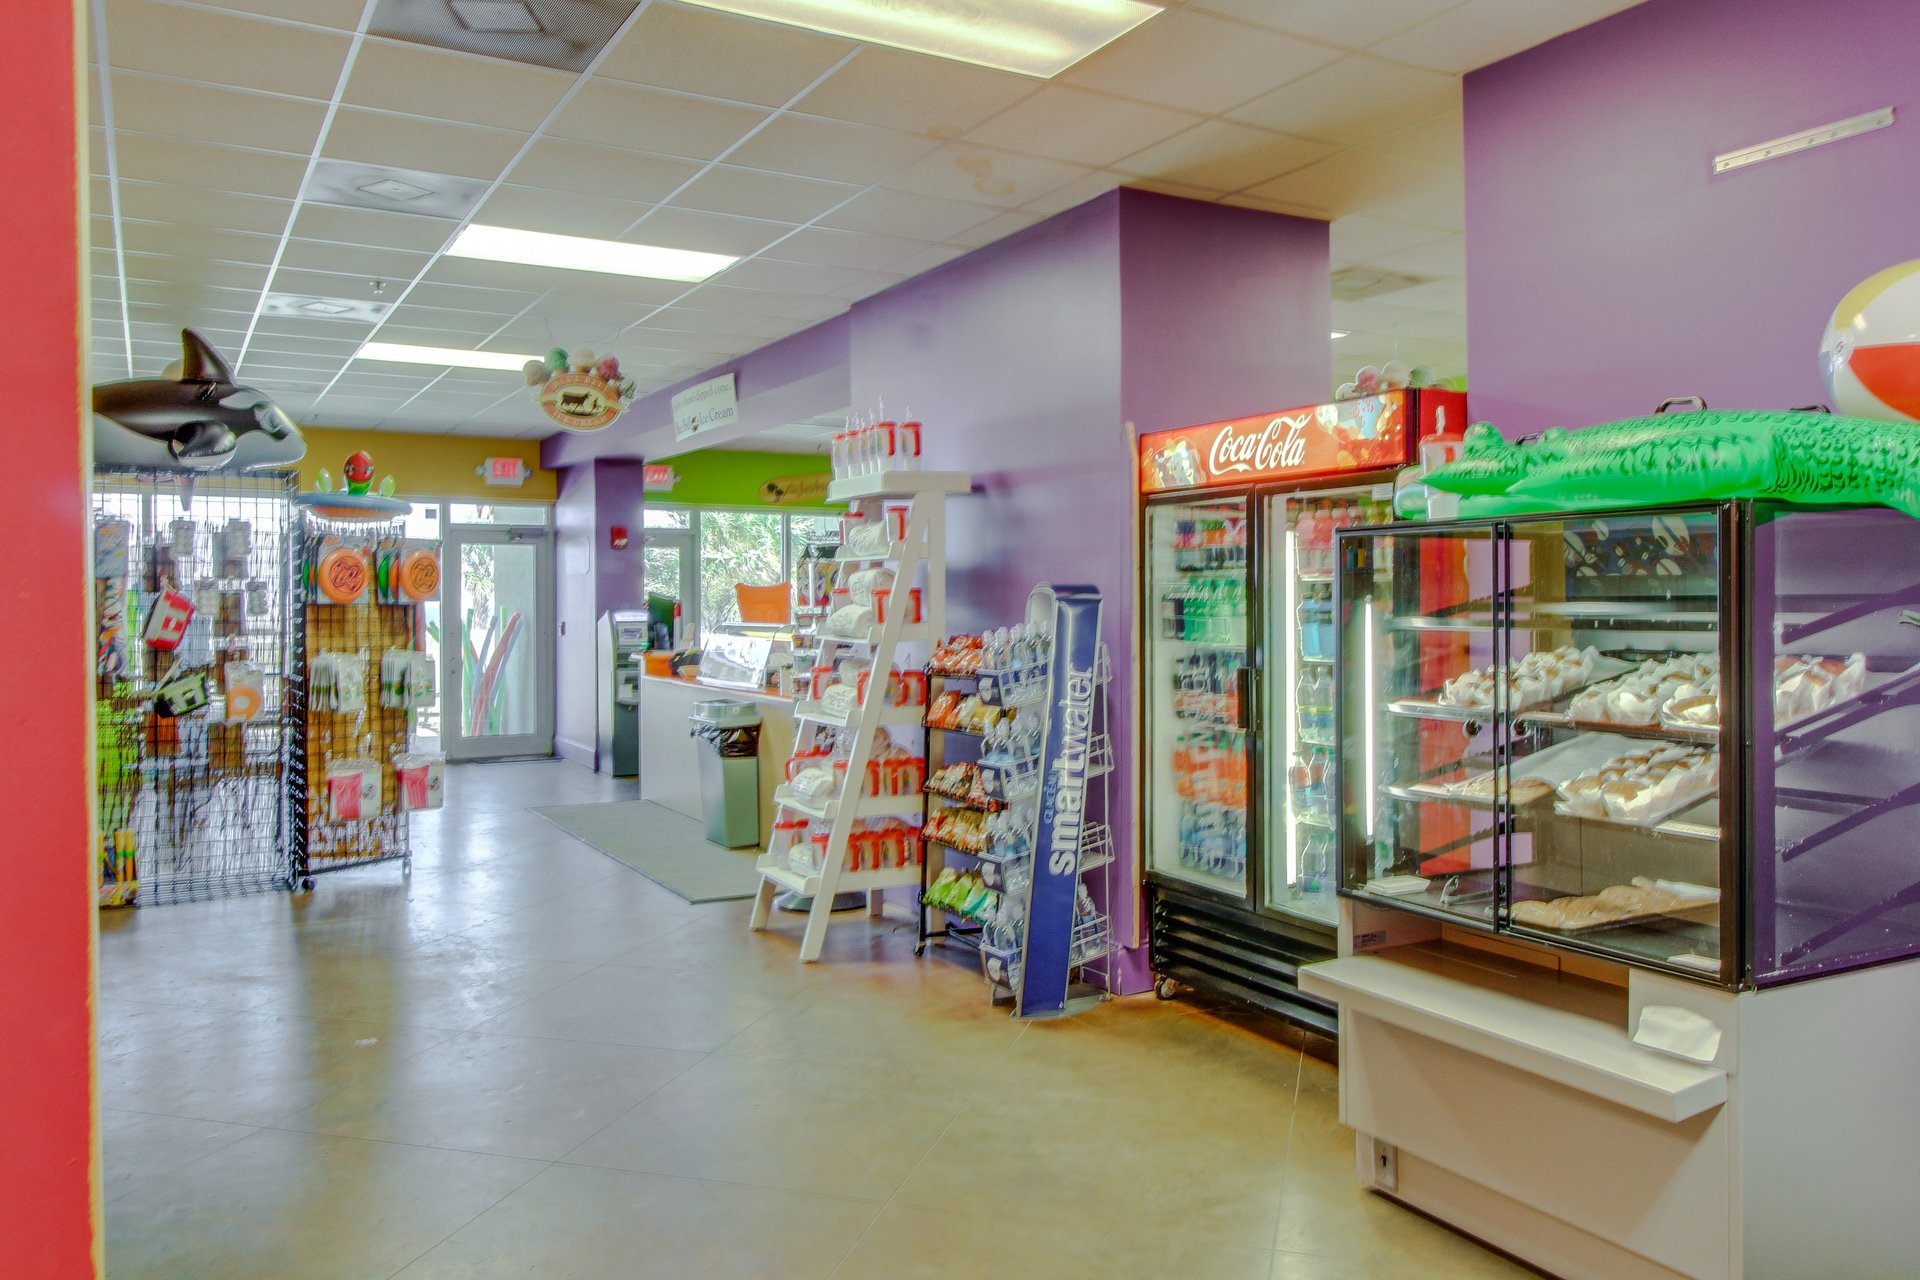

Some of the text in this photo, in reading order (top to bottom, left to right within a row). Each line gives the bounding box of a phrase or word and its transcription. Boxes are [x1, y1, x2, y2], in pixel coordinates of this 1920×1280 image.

[698, 411, 709, 425] Ice
[709, 406, 734, 422] Cream
[1209, 412, 1313, 476] Coca-Cola
[493, 457, 518, 477] EXIT
[1048, 662, 1093, 877] smartwater
